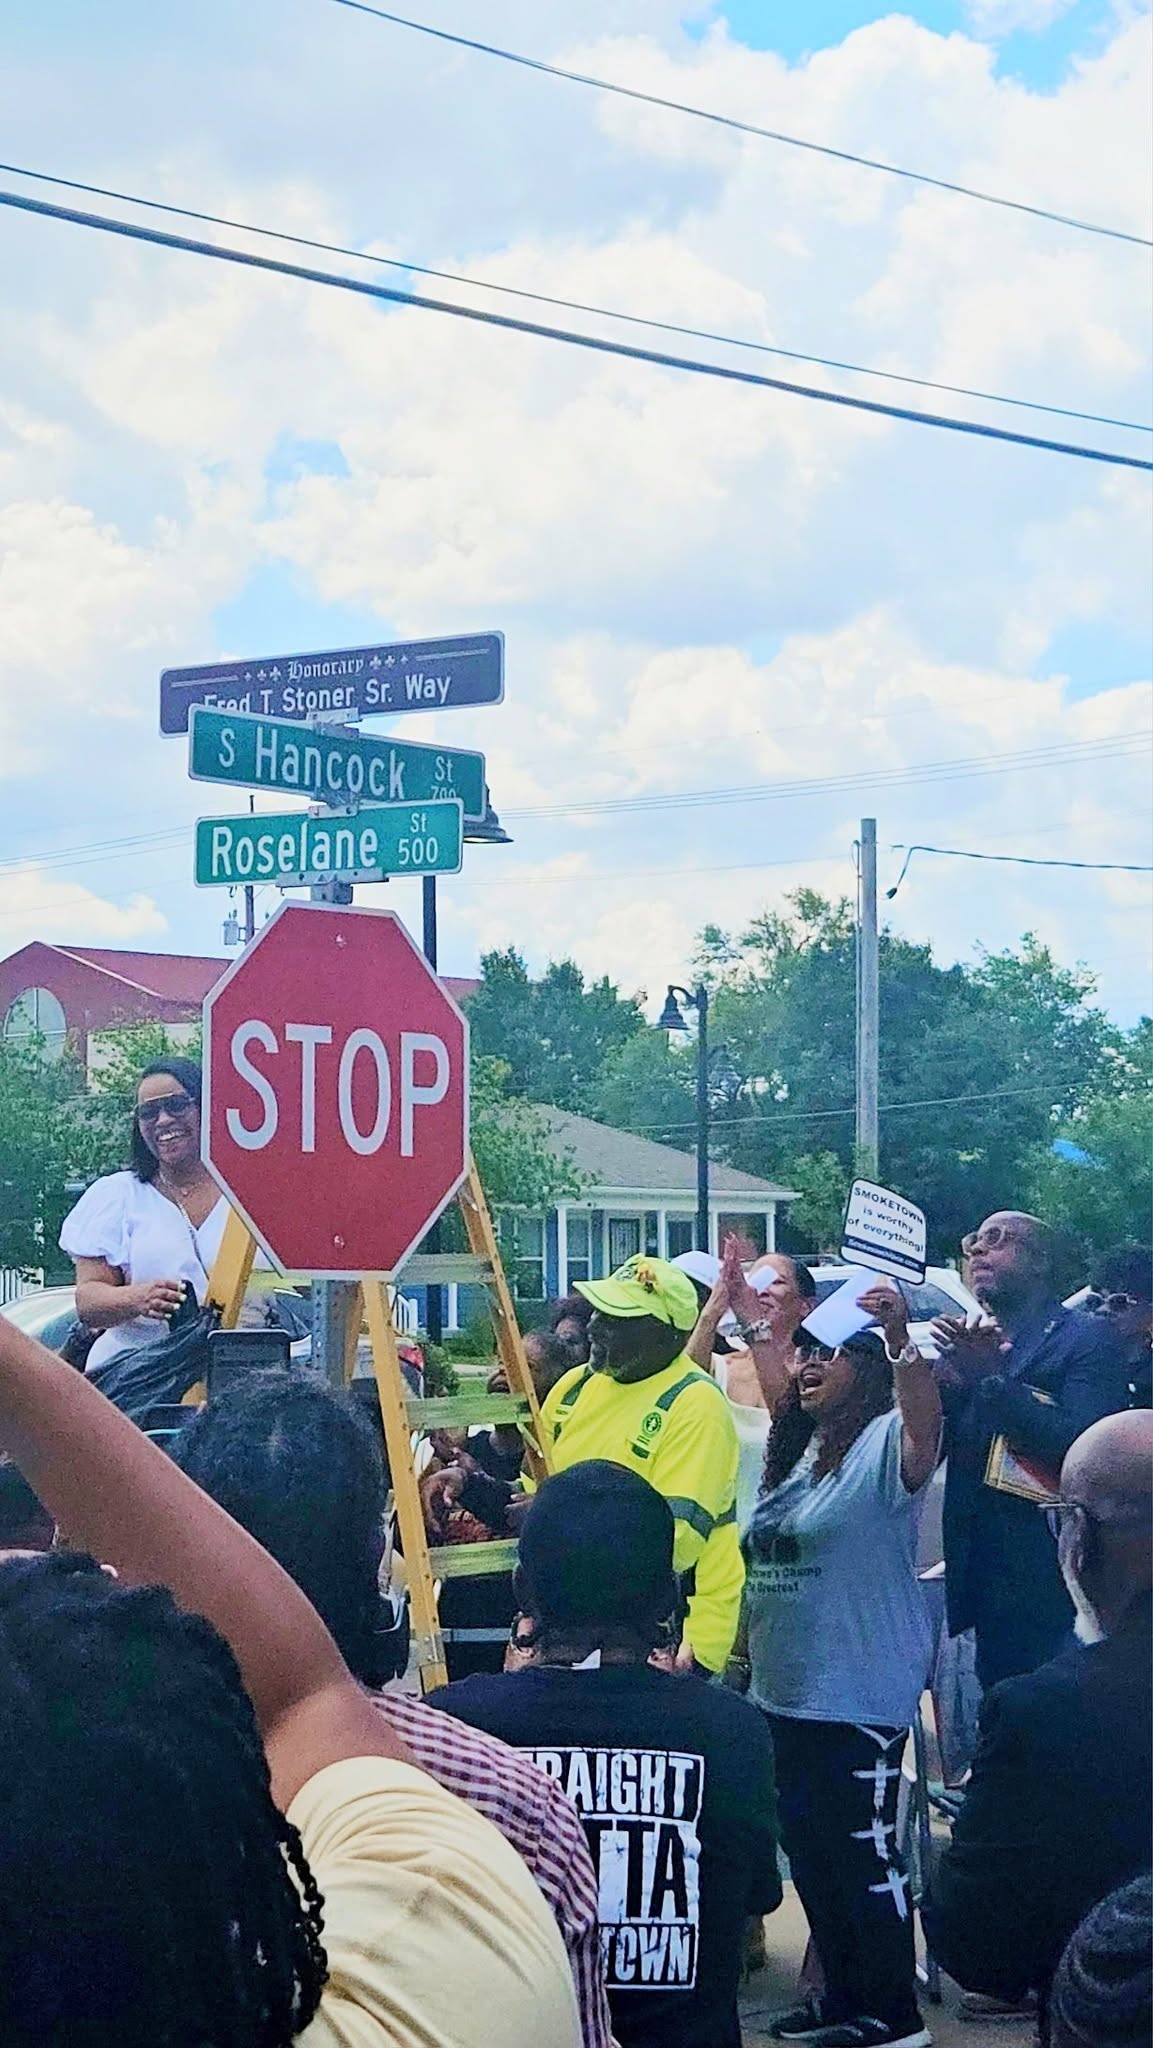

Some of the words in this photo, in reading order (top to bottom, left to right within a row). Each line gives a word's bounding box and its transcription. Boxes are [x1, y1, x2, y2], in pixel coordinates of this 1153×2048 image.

[287, 659, 364, 683] Honorary
[260, 690, 274, 715] T.
[282, 686, 354, 712] Stoner
[366, 678, 392, 704] Sr.
[405, 673, 451, 704] Way
[219, 728, 235, 768] S
[256, 726, 405, 799] Hancock
[435, 755, 454, 783] St
[212, 822, 378, 877] Roselane
[410, 812, 428, 834] St
[398, 837, 439, 866] 500
[226, 1019, 450, 1157] STOP
[854, 1187, 923, 1225] SMOKETOWN
[863, 1207, 873, 1216] is
[877, 1213, 914, 1234] worthy
[863, 1223, 924, 1252] everything!
[520, 1752, 693, 1817] RAIGHT
